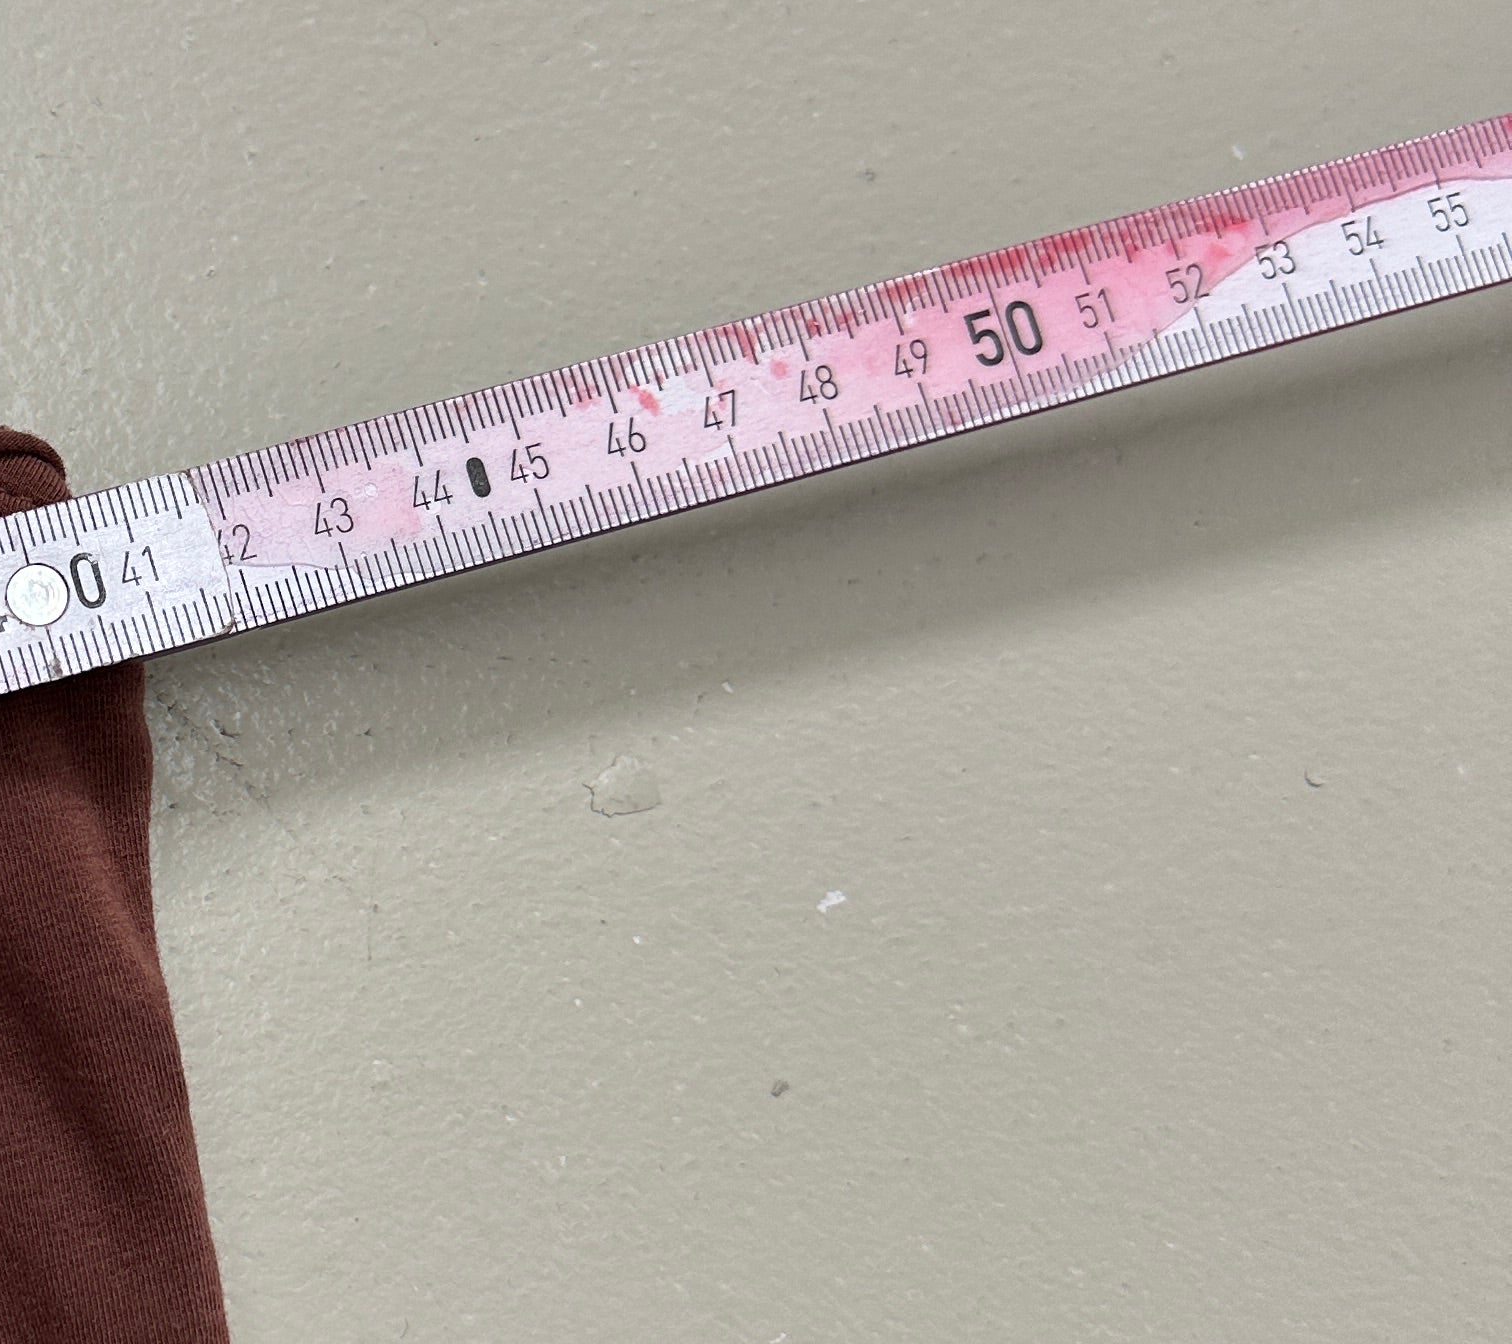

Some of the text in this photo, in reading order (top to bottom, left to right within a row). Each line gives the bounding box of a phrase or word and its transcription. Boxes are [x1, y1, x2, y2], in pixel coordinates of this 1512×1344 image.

[121, 546, 161, 587] 41
[313, 497, 355, 537] 43
[412, 470, 454, 511] 44
[510, 442, 550, 484] 45
[607, 417, 647, 458] 46
[703, 389, 736, 431] 47
[799, 365, 840, 406] 48
[894, 339, 929, 379] 49
[963, 300, 1044, 366] 50
[1075, 289, 1117, 329] 51
[1165, 263, 1210, 305] 52
[1255, 239, 1298, 280] 53
[1341, 215, 1385, 256] 54
[1427, 192, 1471, 233] 55
